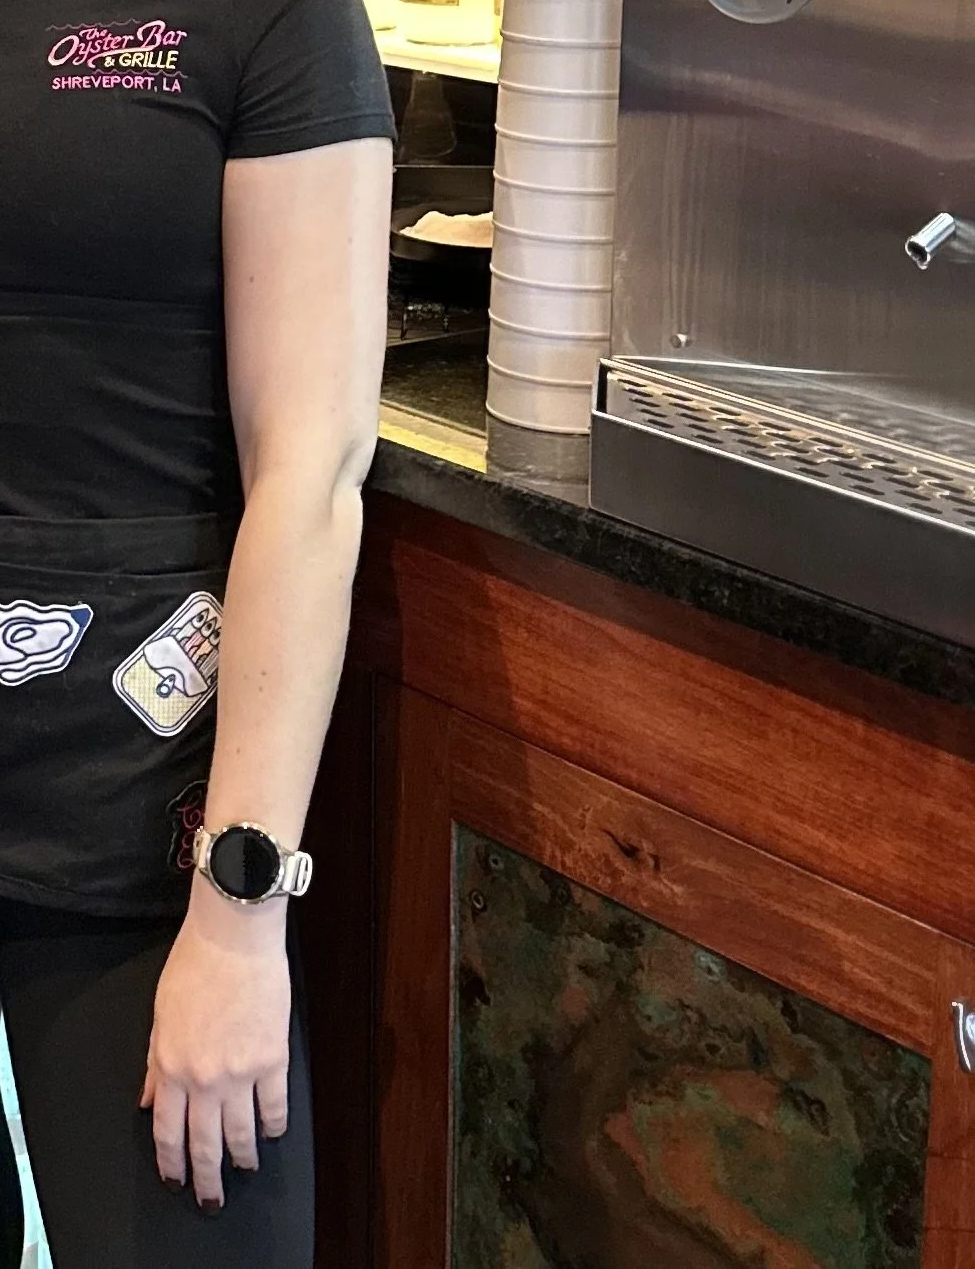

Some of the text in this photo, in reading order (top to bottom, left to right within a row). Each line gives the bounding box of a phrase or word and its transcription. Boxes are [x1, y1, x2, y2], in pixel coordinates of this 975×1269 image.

[48, 20, 187, 67] Oyster Bar
[79, 28, 106, 42] The
[104, 50, 179, 70] & GRILLE
[51, 75, 182, 93] SHREVEPORT, LA
